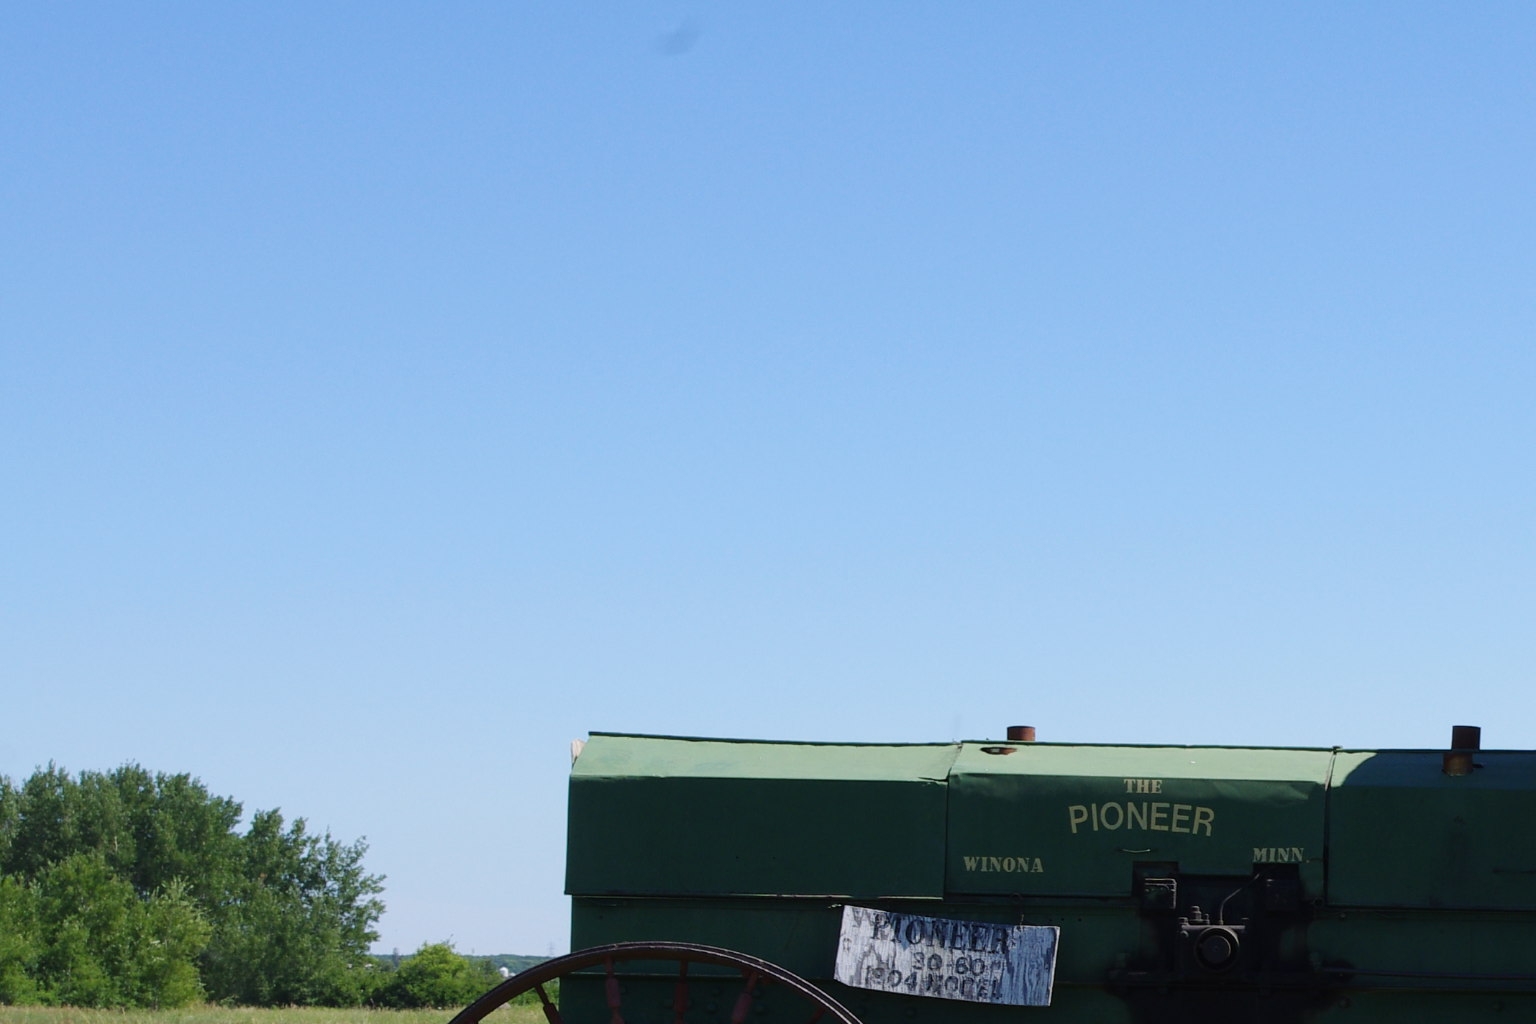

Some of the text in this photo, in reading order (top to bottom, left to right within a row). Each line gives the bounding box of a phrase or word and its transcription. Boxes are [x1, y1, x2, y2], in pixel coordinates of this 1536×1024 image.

[1123, 778, 1163, 794] THE
[1068, 801, 1215, 837] PIONEER
[963, 856, 1044, 873] WINONA
[870, 912, 1009, 955] PIONEER
